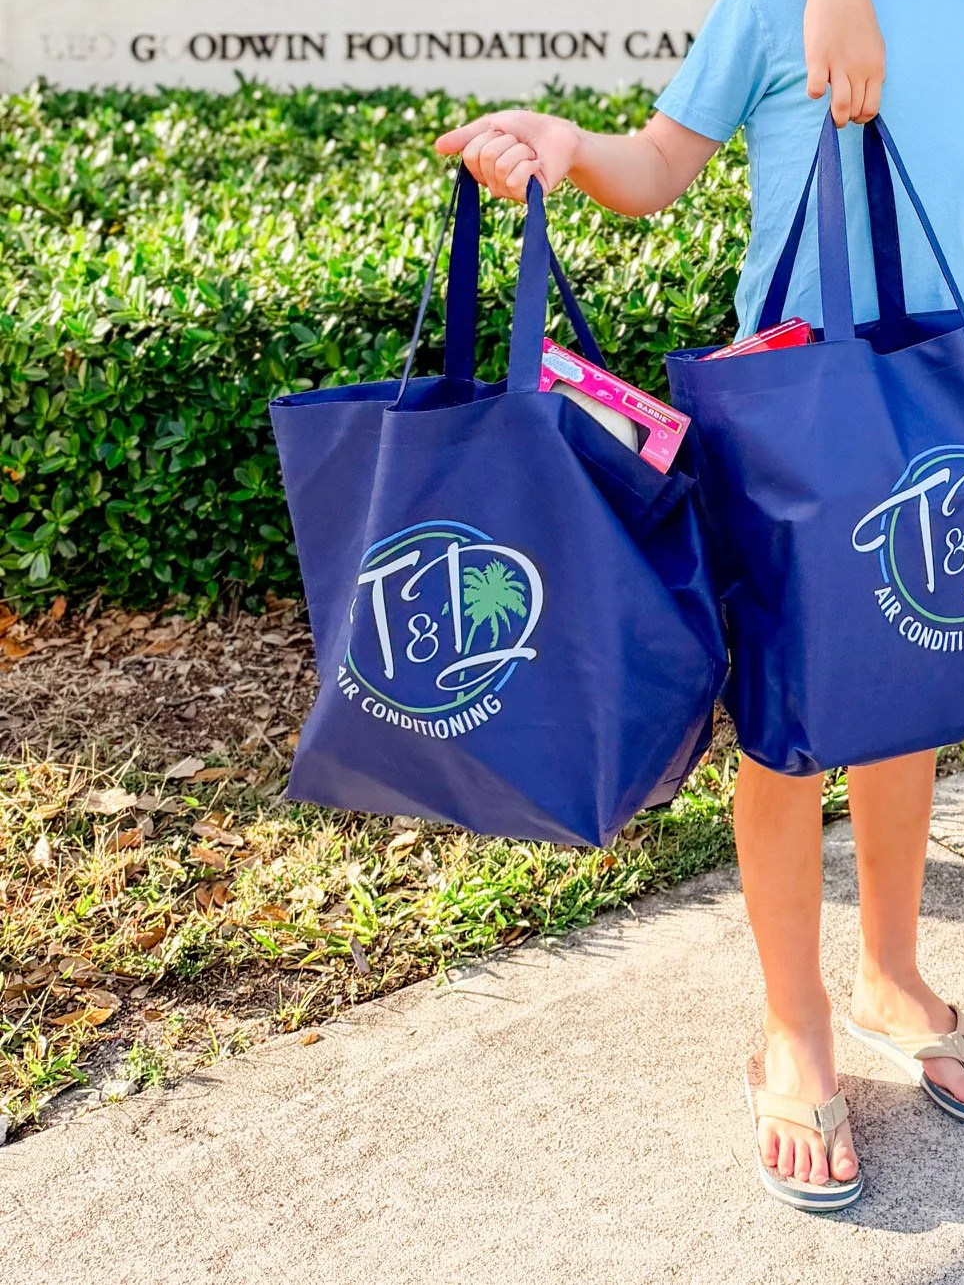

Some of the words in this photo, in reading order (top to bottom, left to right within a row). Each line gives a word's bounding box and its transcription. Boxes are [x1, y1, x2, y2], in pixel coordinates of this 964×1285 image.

[345, 31, 609, 61] FOUNDATION
[874, 586, 901, 623] AIR
[337, 665, 359, 700] AIR
[361, 693, 502, 739] CONDITIONING
